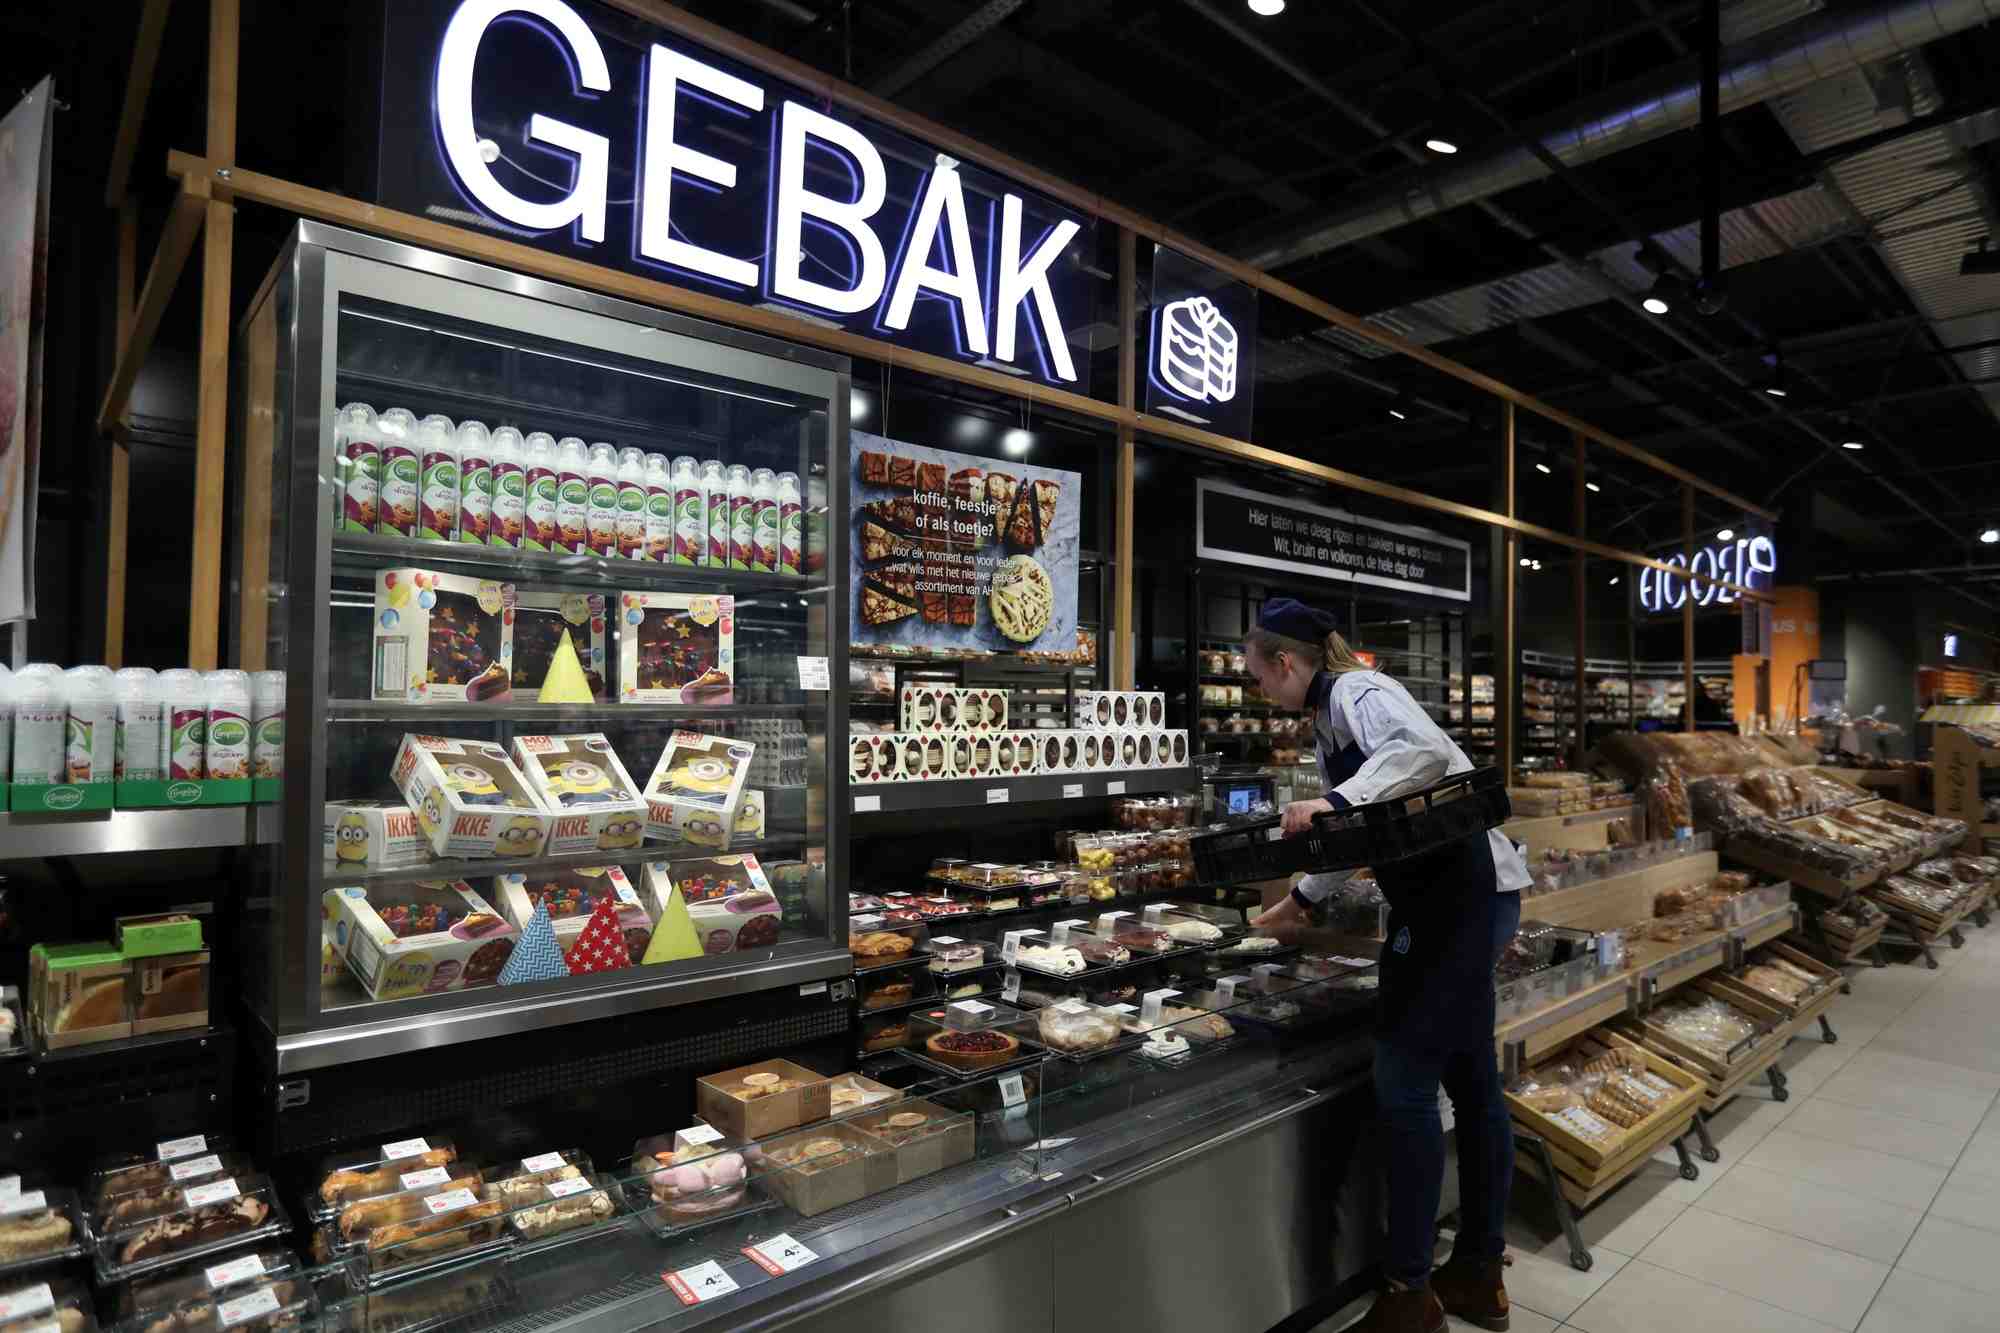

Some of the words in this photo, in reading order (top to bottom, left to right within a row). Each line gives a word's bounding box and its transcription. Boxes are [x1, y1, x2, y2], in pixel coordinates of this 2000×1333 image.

[434, 0, 1082, 384] GEBAK
[913, 489, 951, 510] koffie,
[955, 496, 996, 517] feestje
[915, 514, 929, 528] of
[932, 516, 950, 531] als
[953, 520, 994, 538] toetje?
[1248, 507, 1269, 528] Hier
[911, 546, 925, 559] elk
[926, 551, 961, 564] moment
[963, 555, 975, 565] en
[1292, 540, 1316, 559] bruin
[1317, 547, 1329, 560] en
[926, 566, 943, 578] met
[945, 566, 960, 579] het
[914, 581, 963, 594] assortiment
[965, 585, 980, 595] van
[452, 814, 491, 838] IKKE
[555, 815, 591, 839] IKKE
